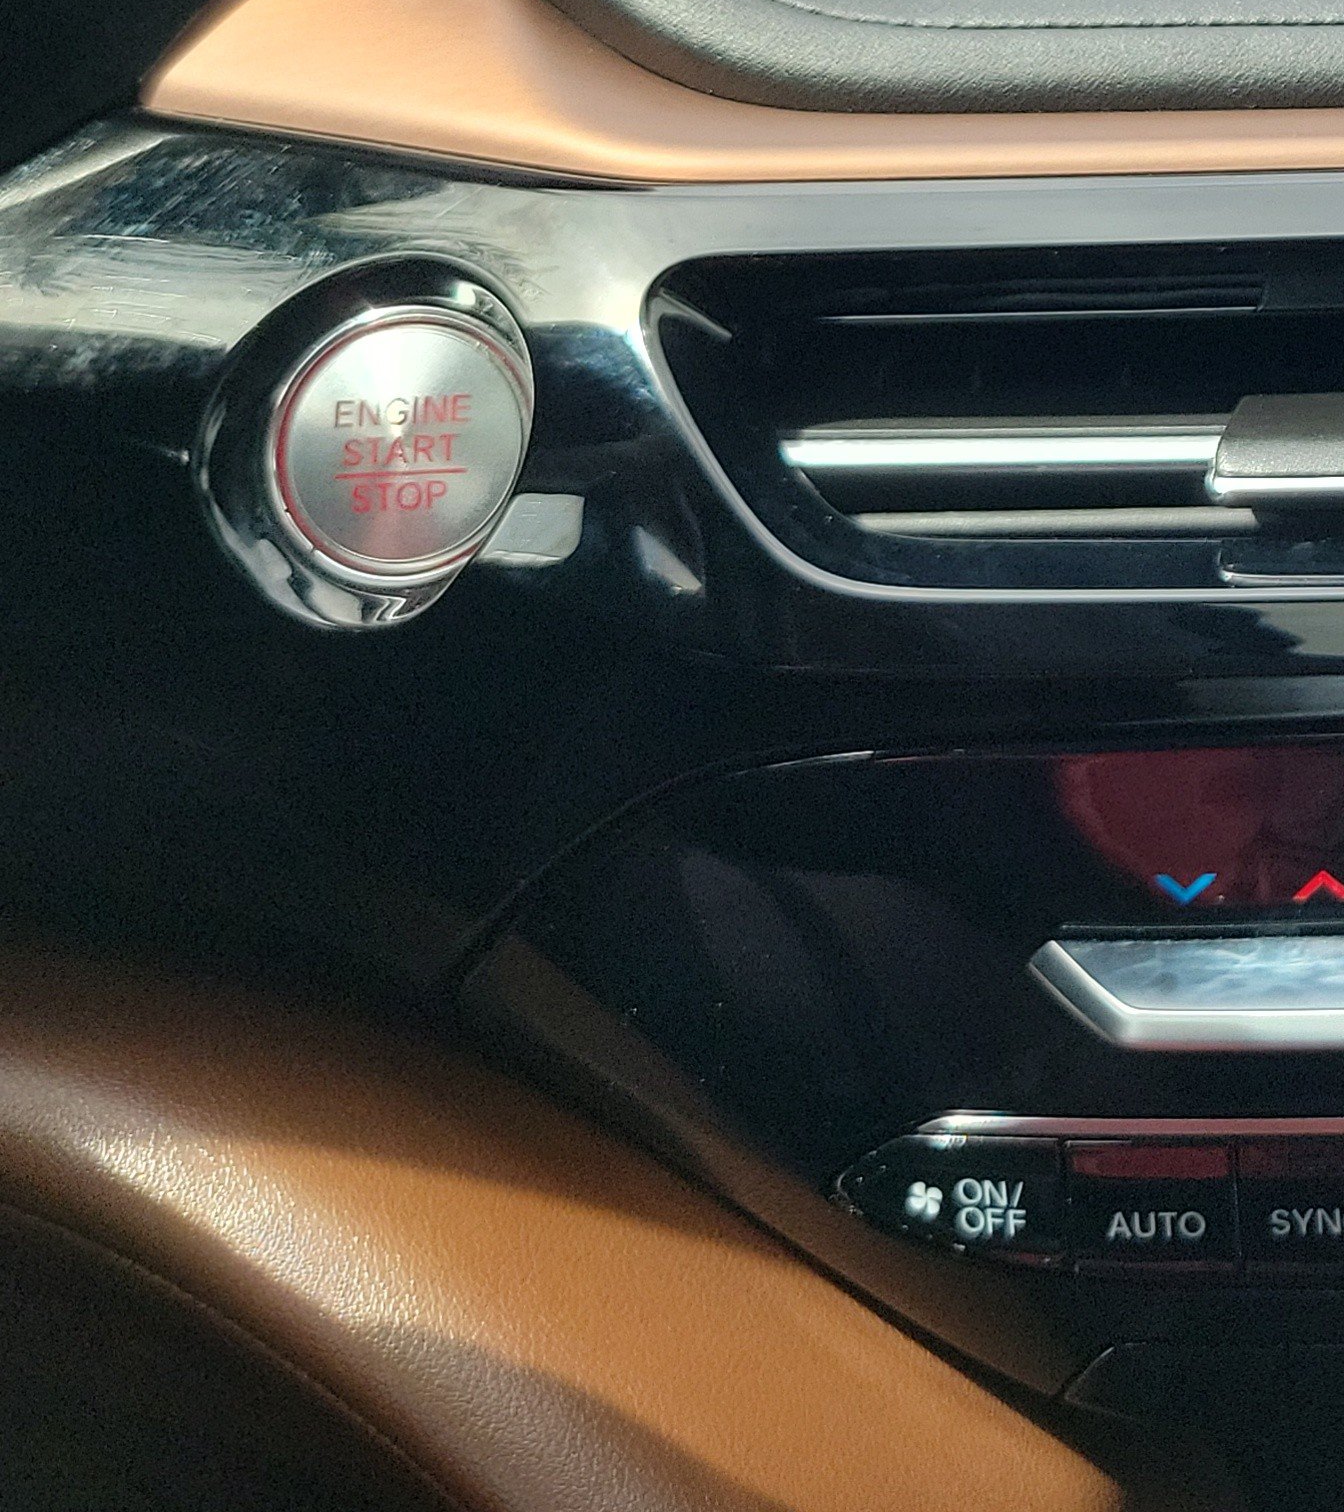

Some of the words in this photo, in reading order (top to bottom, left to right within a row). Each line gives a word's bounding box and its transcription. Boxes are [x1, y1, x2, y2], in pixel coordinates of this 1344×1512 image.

[335, 394, 472, 428] ENGINE
[342, 433, 459, 467] START
[352, 480, 446, 513] STOP
[955, 1178, 1024, 1208] ON/
[957, 1206, 1027, 1239] OFF
[1107, 1210, 1207, 1241] AUTO
